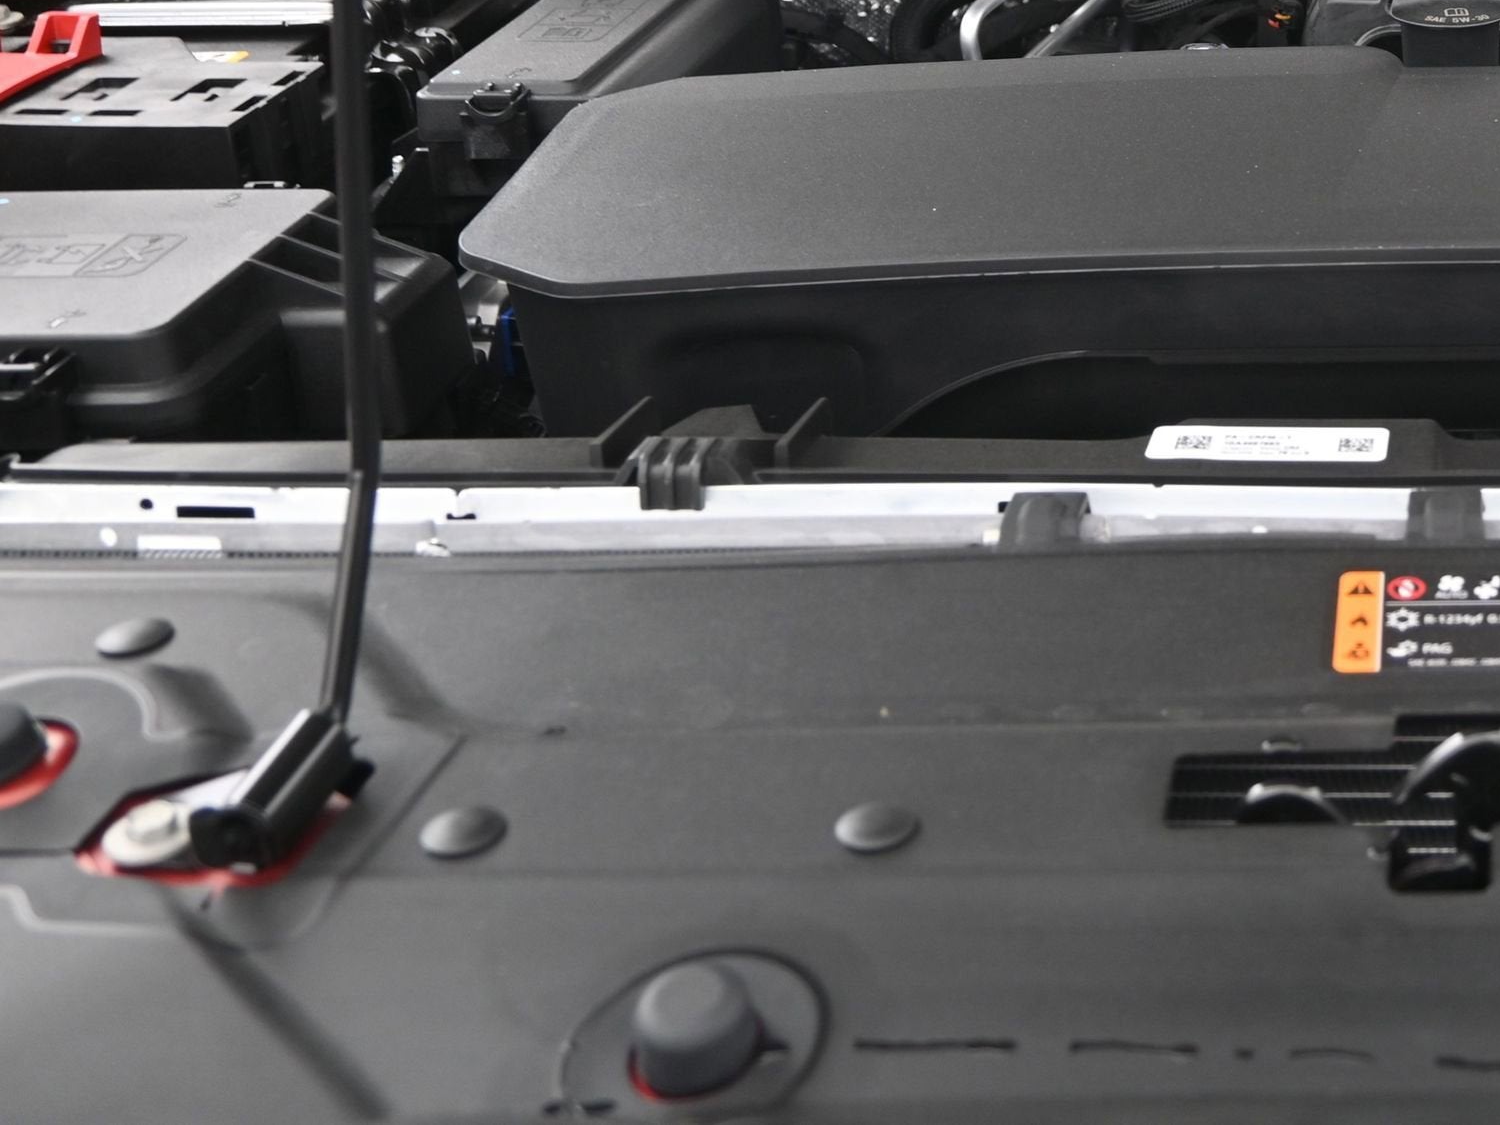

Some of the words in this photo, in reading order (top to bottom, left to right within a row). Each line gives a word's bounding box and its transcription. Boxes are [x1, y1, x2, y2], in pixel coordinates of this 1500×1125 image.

[1425, 15, 1446, 23] SAE
[1452, 14, 1490, 23] 5W-30
[1422, 642, 1453, 655] PAG
